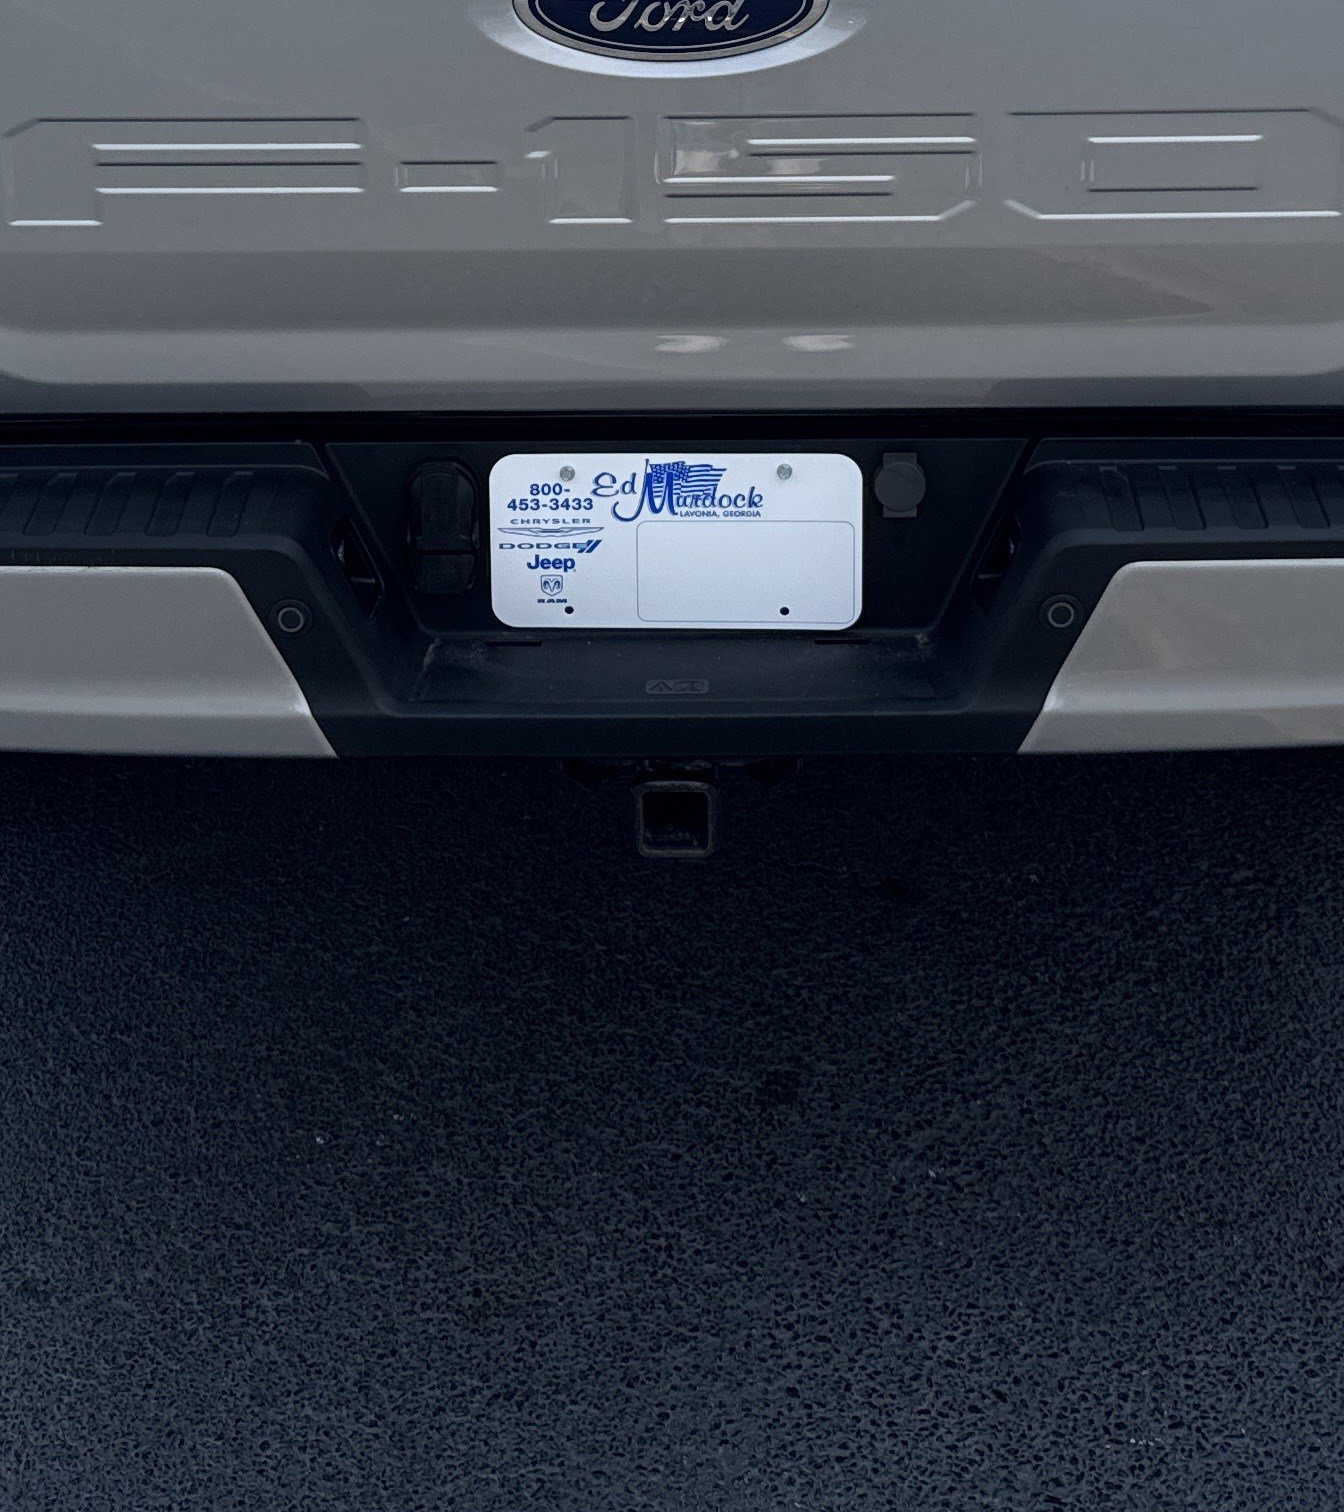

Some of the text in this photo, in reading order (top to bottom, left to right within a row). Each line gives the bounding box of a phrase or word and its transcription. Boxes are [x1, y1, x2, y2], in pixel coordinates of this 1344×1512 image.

[529, 483, 571, 496] 800-
[591, 472, 764, 522] Ed Murdock
[507, 498, 594, 511] 453-3433
[679, 510, 761, 518] LAVONIA, GEORGIA
[526, 554, 576, 572] Jeep
